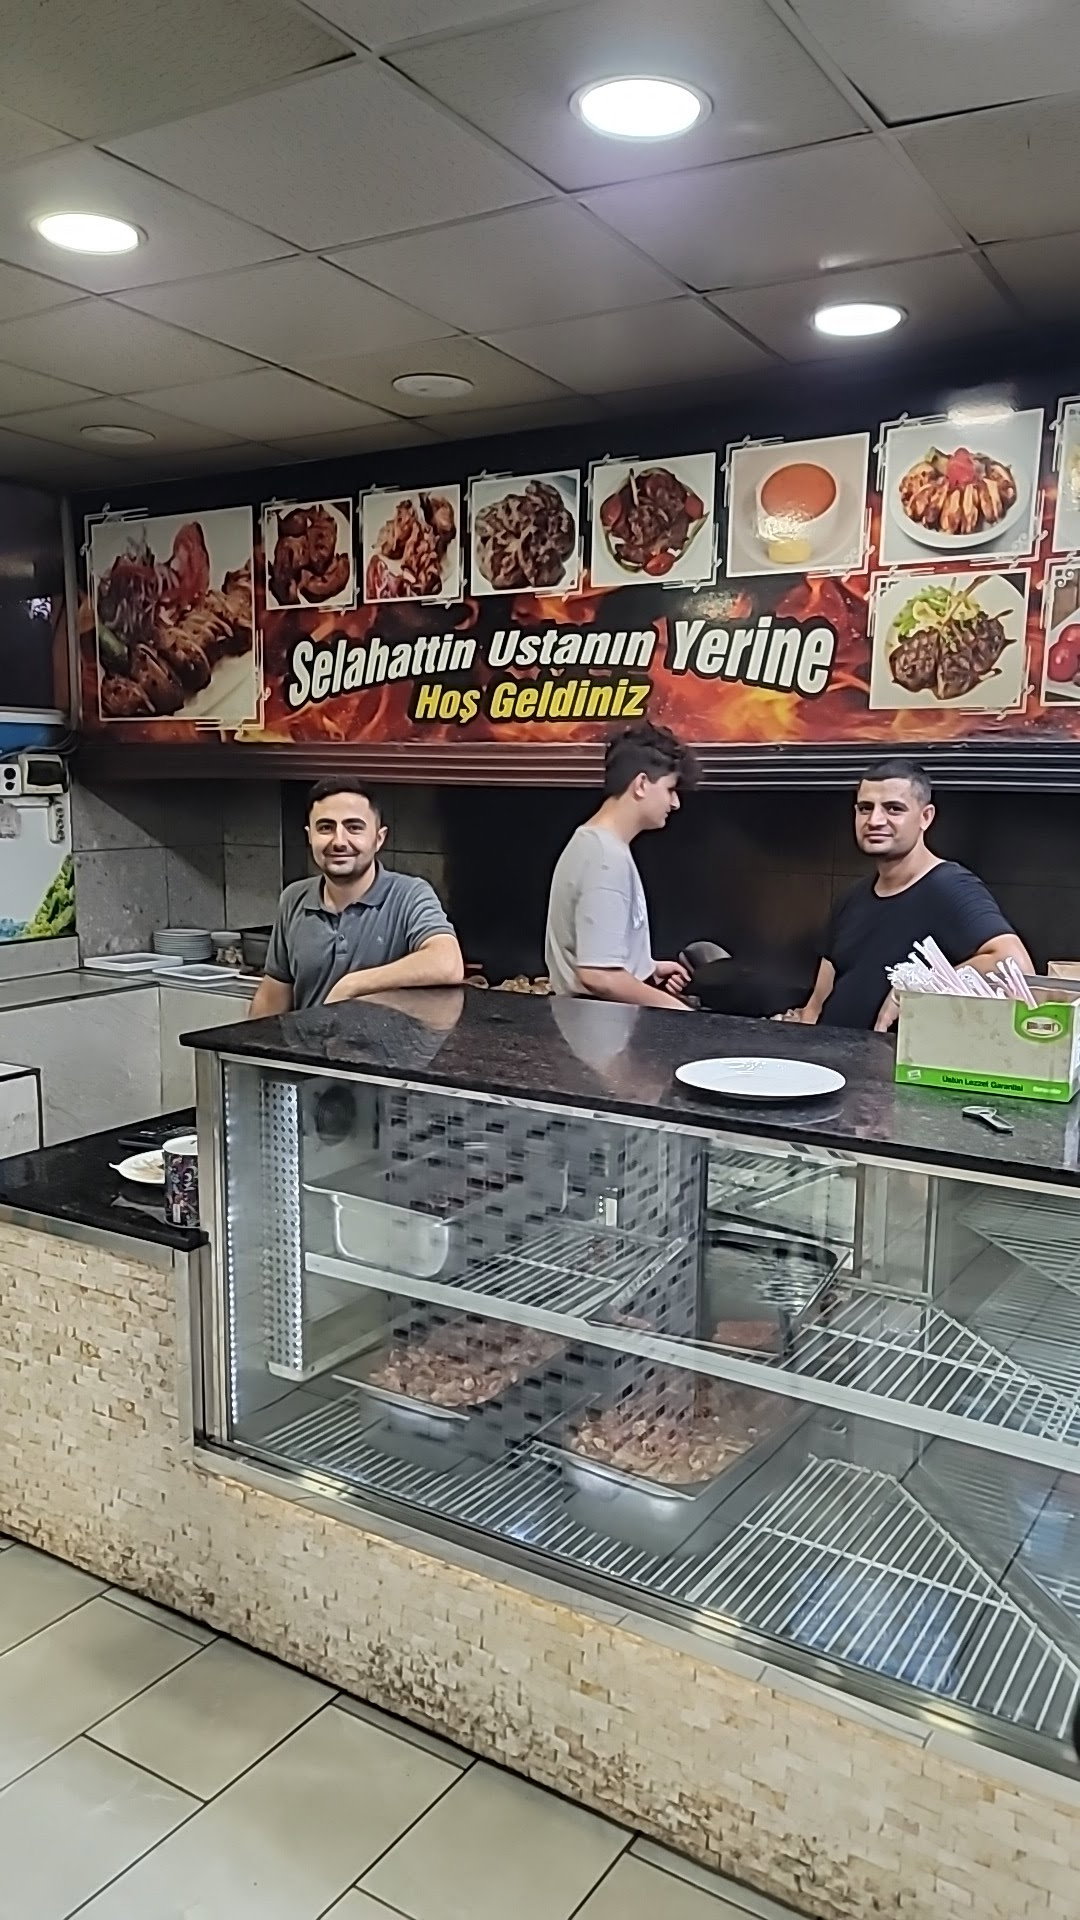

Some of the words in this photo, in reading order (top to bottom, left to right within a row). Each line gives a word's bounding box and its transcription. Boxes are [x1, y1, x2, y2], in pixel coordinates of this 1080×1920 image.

[288, 634, 477, 707] Selahattin
[488, 628, 656, 668] Ustanın
[671, 616, 835, 694] Yerine
[415, 684, 480, 723] Hoş
[490, 679, 650, 718] Geldiniz
